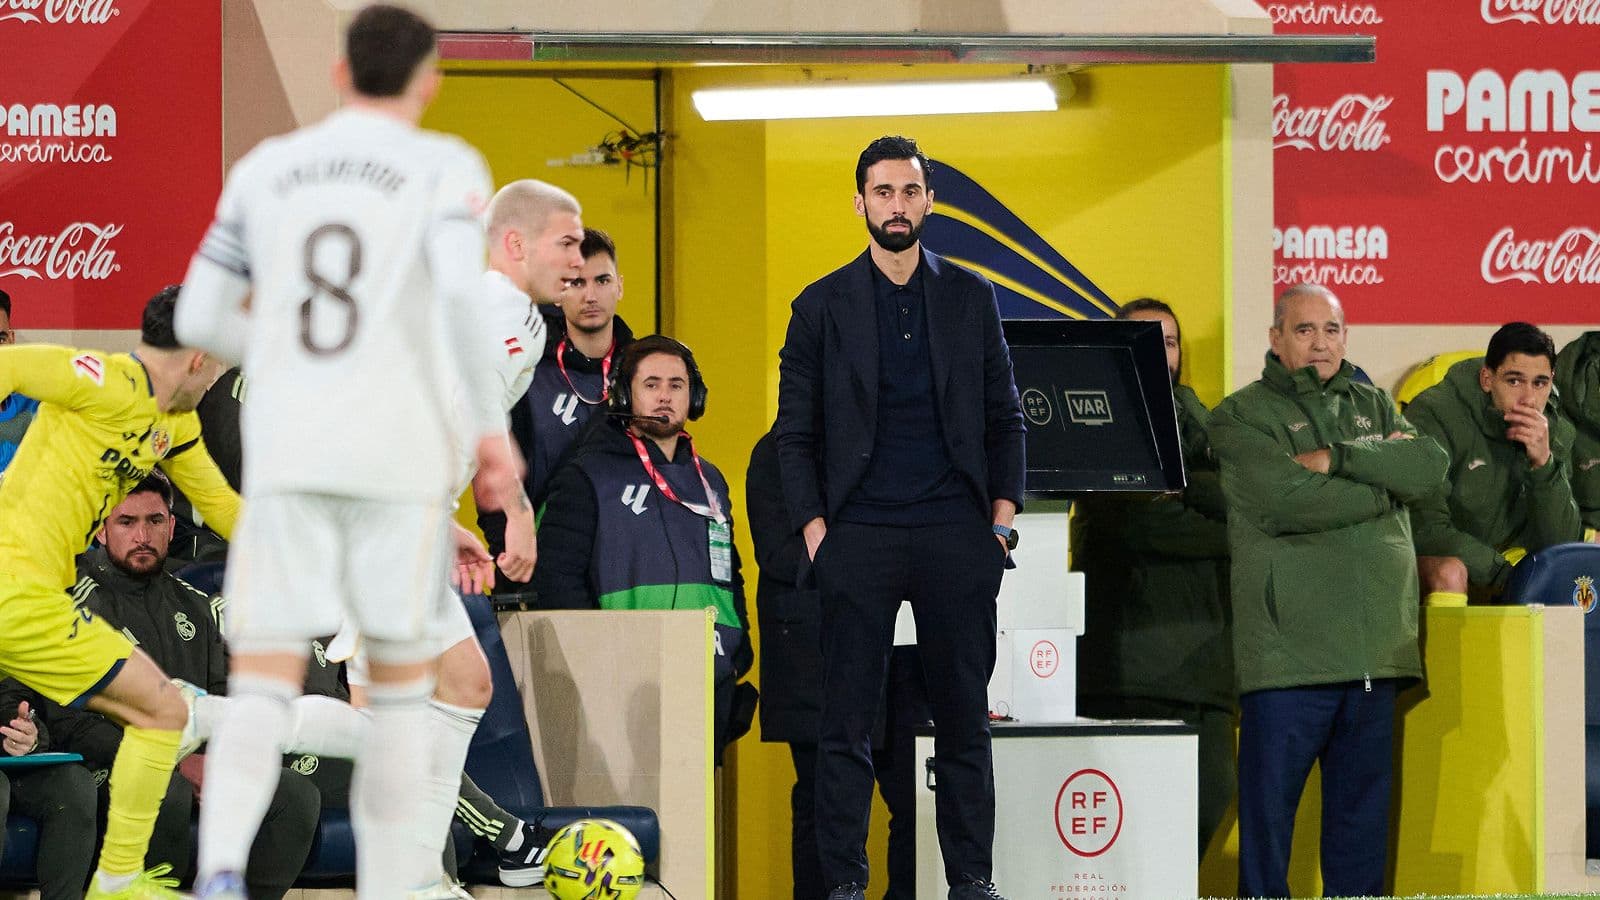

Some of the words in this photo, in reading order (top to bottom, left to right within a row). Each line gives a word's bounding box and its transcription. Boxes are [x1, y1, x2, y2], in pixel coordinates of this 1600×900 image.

[1267, 1, 1383, 24] cerámica
[1426, 69, 1600, 132] PAME
[0, 138, 112, 162] erámica
[298, 221, 362, 355] 8
[1072, 398, 1107, 415] VAR
